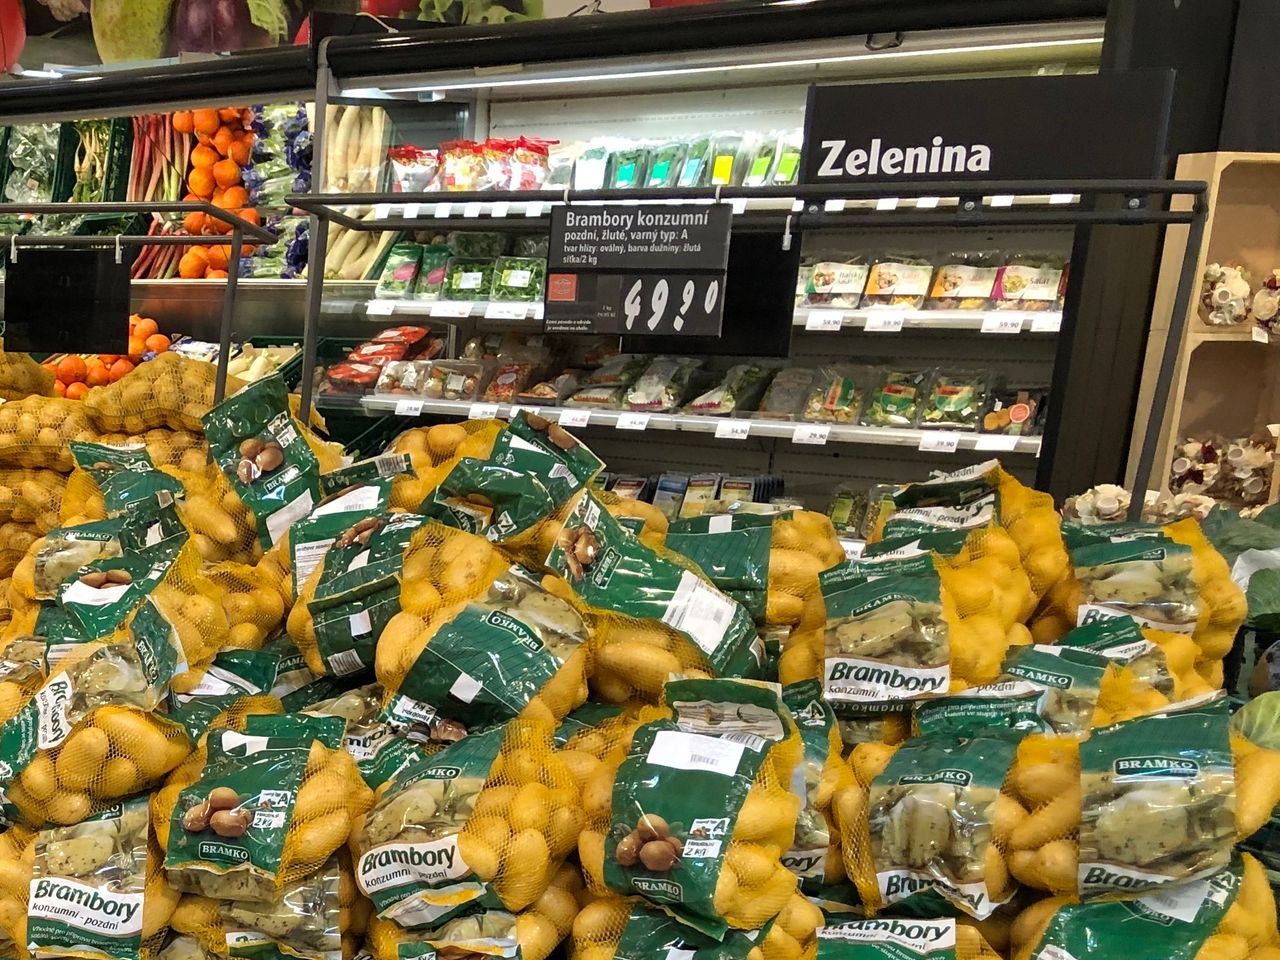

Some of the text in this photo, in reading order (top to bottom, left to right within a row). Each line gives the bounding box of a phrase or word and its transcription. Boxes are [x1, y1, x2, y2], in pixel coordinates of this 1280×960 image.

[818, 136, 991, 176] Zelenina
[566, 209, 709, 230] Brambory konzumní
[564, 229, 688, 243] pozdní, žluté, varný typ: A
[588, 255, 598, 266] kg
[491, 614, 539, 650] BRAMKO
[829, 662, 946, 692] Brambory
[425, 707, 433, 715] 2
[1119, 759, 1194, 770] BRAMKO
[277, 793, 288, 805] A
[254, 818, 261, 826] 2
[713, 820, 727, 832] A
[202, 844, 249, 860] BRAMKO
[684, 848, 694, 856] 2
[361, 845, 455, 875] Brambory
[365, 868, 411, 888] konzumní
[635, 881, 679, 895] BRAMKO
[34, 880, 139, 923] Brambory
[32, 903, 79, 918] konzumní
[83, 916, 120, 930] pozdní
[426, 952, 435, 960] 2
